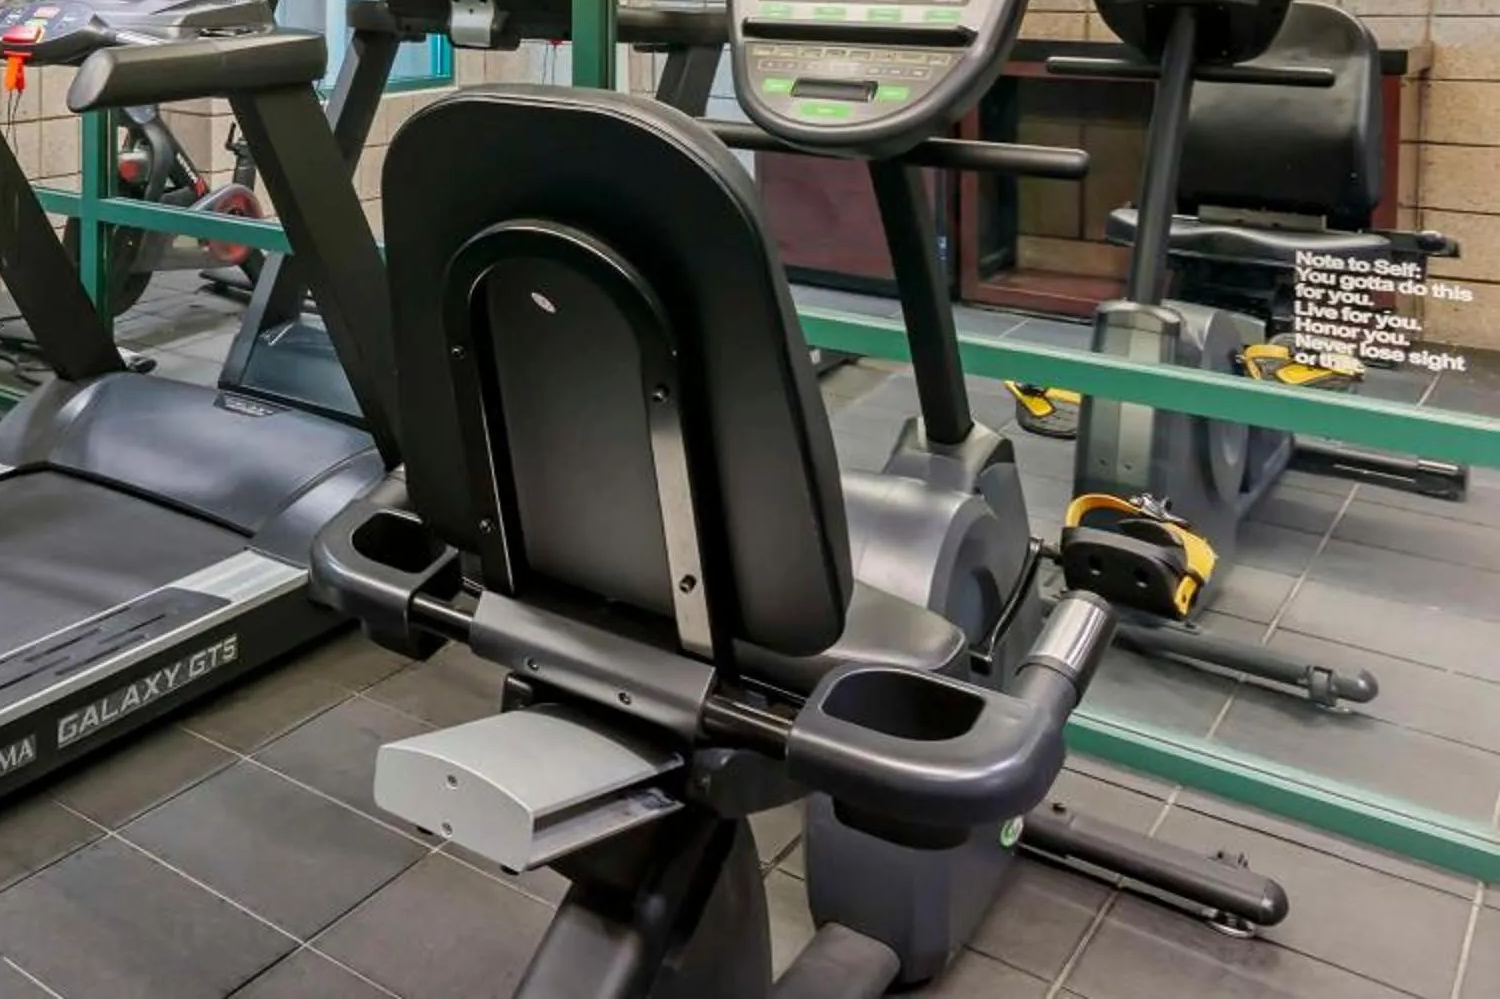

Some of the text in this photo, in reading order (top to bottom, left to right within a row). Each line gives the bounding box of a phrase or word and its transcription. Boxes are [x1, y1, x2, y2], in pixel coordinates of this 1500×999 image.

[1296, 251, 1422, 279] Note to Self:
[1295, 267, 1474, 302] You gotta do this
[1295, 283, 1374, 306] for you.
[1294, 300, 1422, 331] Live for you.
[1295, 316, 1411, 346] Honor you.
[1296, 333, 1466, 372] Never lose sight
[56, 661, 181, 748] GALAXY
